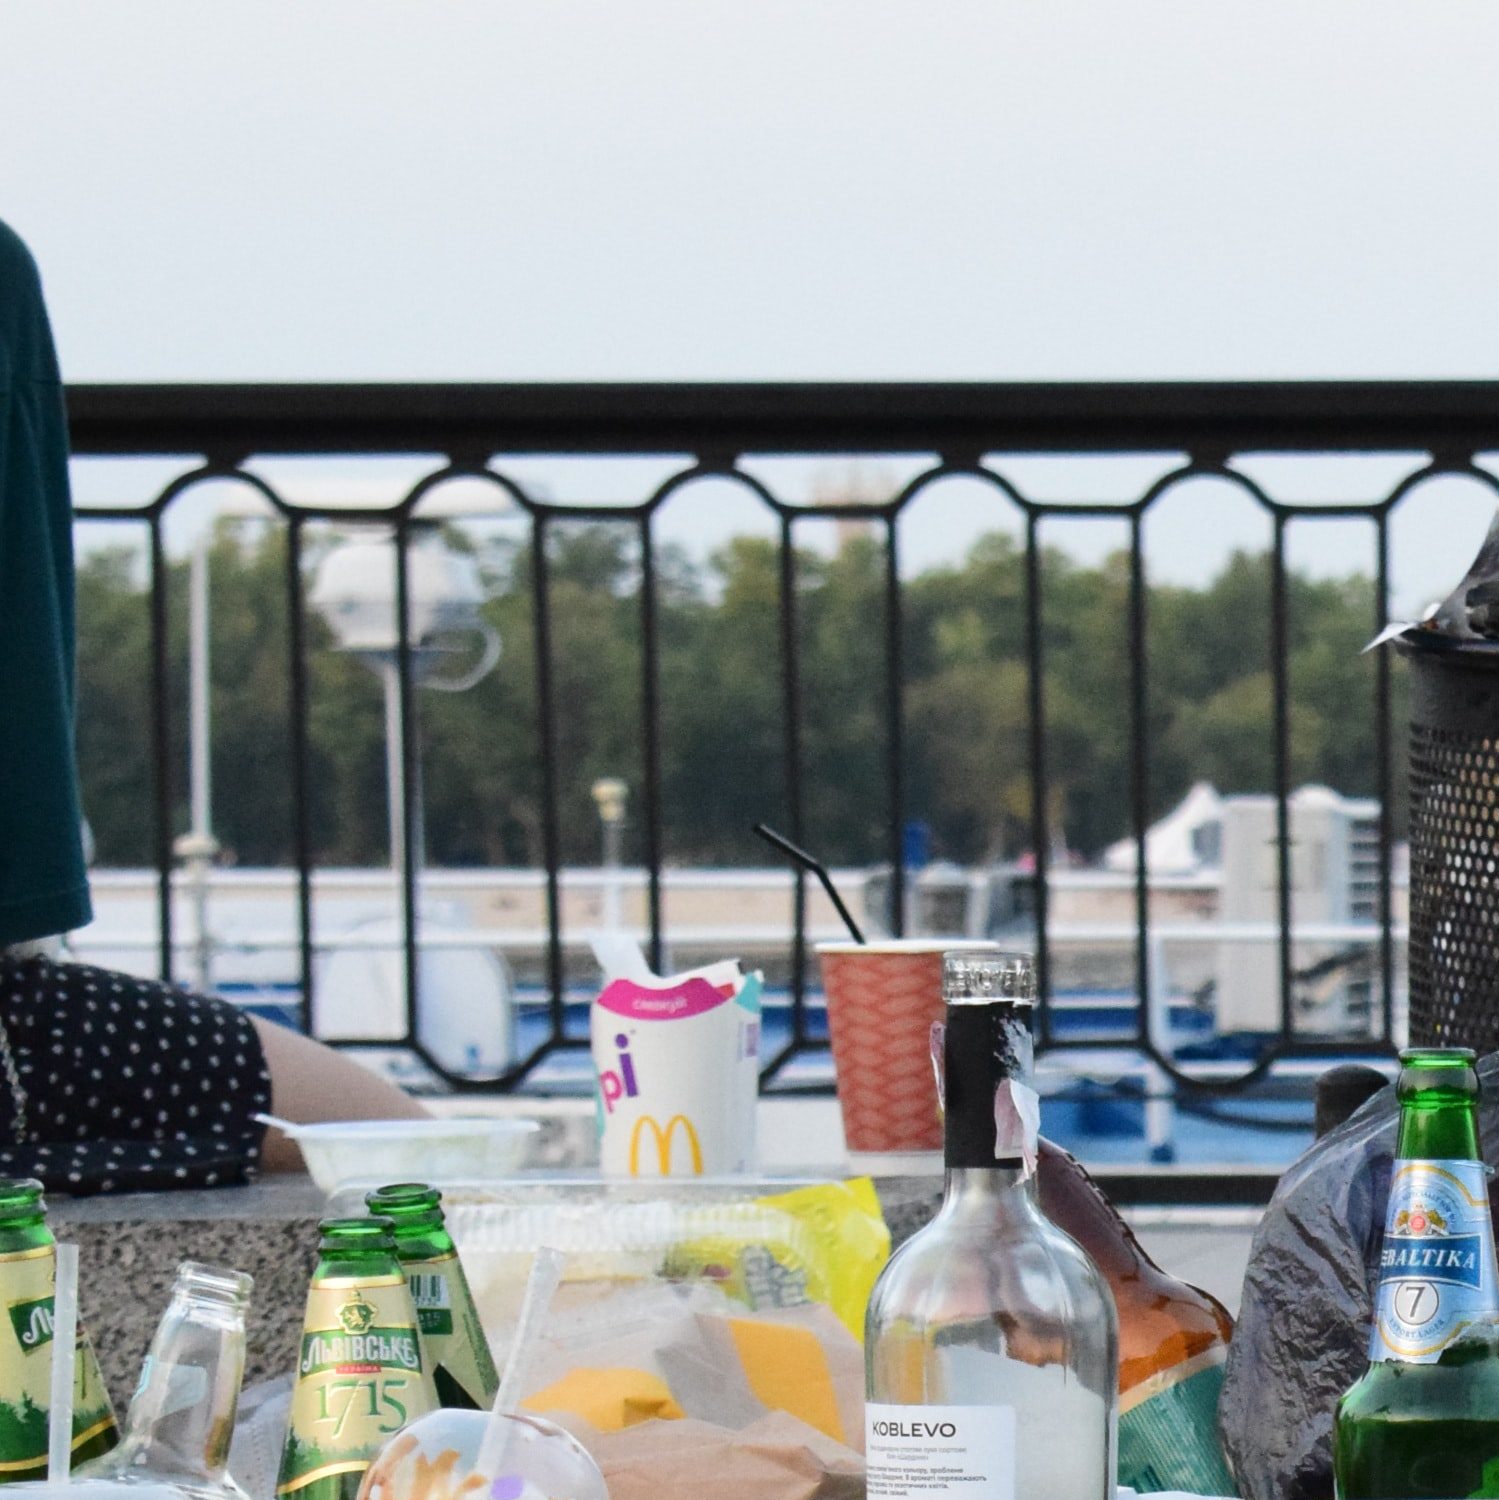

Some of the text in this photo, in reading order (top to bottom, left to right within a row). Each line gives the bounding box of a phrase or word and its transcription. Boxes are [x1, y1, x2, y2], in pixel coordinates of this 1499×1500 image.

[1405, 1286, 1426, 1319] 7
[1418, 1319, 1446, 1338] LAGER
[302, 1334, 419, 1373] ЛЬВІВСЬКЕ
[313, 1379, 410, 1440] 1715
[872, 1421, 957, 1438] KOBLEVO
